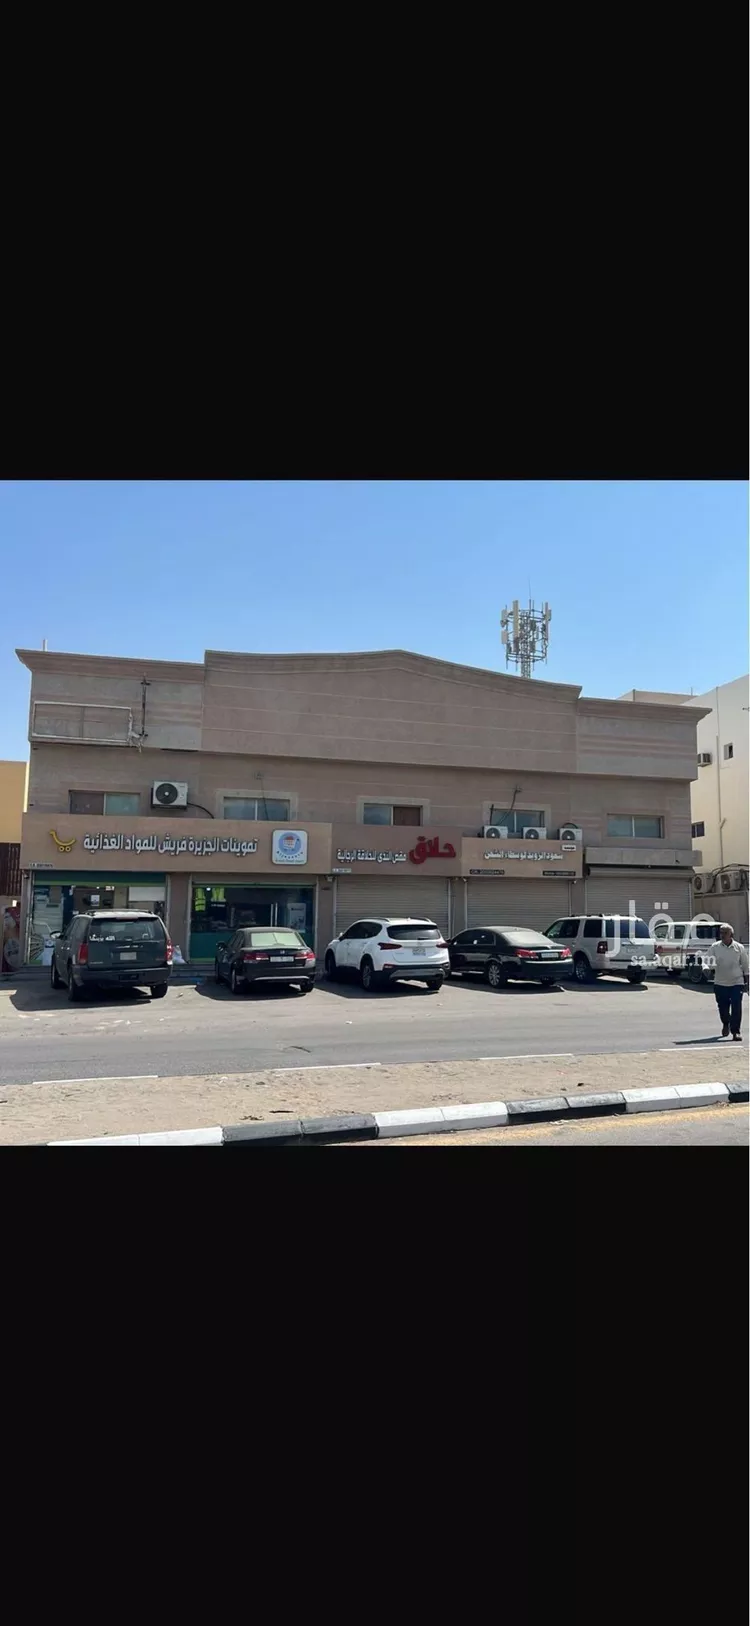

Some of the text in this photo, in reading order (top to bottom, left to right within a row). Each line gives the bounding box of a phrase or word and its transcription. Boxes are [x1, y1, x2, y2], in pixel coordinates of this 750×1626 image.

[83, 832, 124, 854] الغذائية
[125, 834, 157, 854] للمواد
[158, 833, 187, 855] فريش
[188, 835, 219, 856] الجزيرة
[220, 837, 259, 857] تموينات
[409, 836, 456, 865] حلاق
[336, 848, 356, 863] الرجالية
[357, 849, 377, 861] للحلاقة
[394, 851, 407, 864] مقص
[546, 852, 564, 861] سعود
